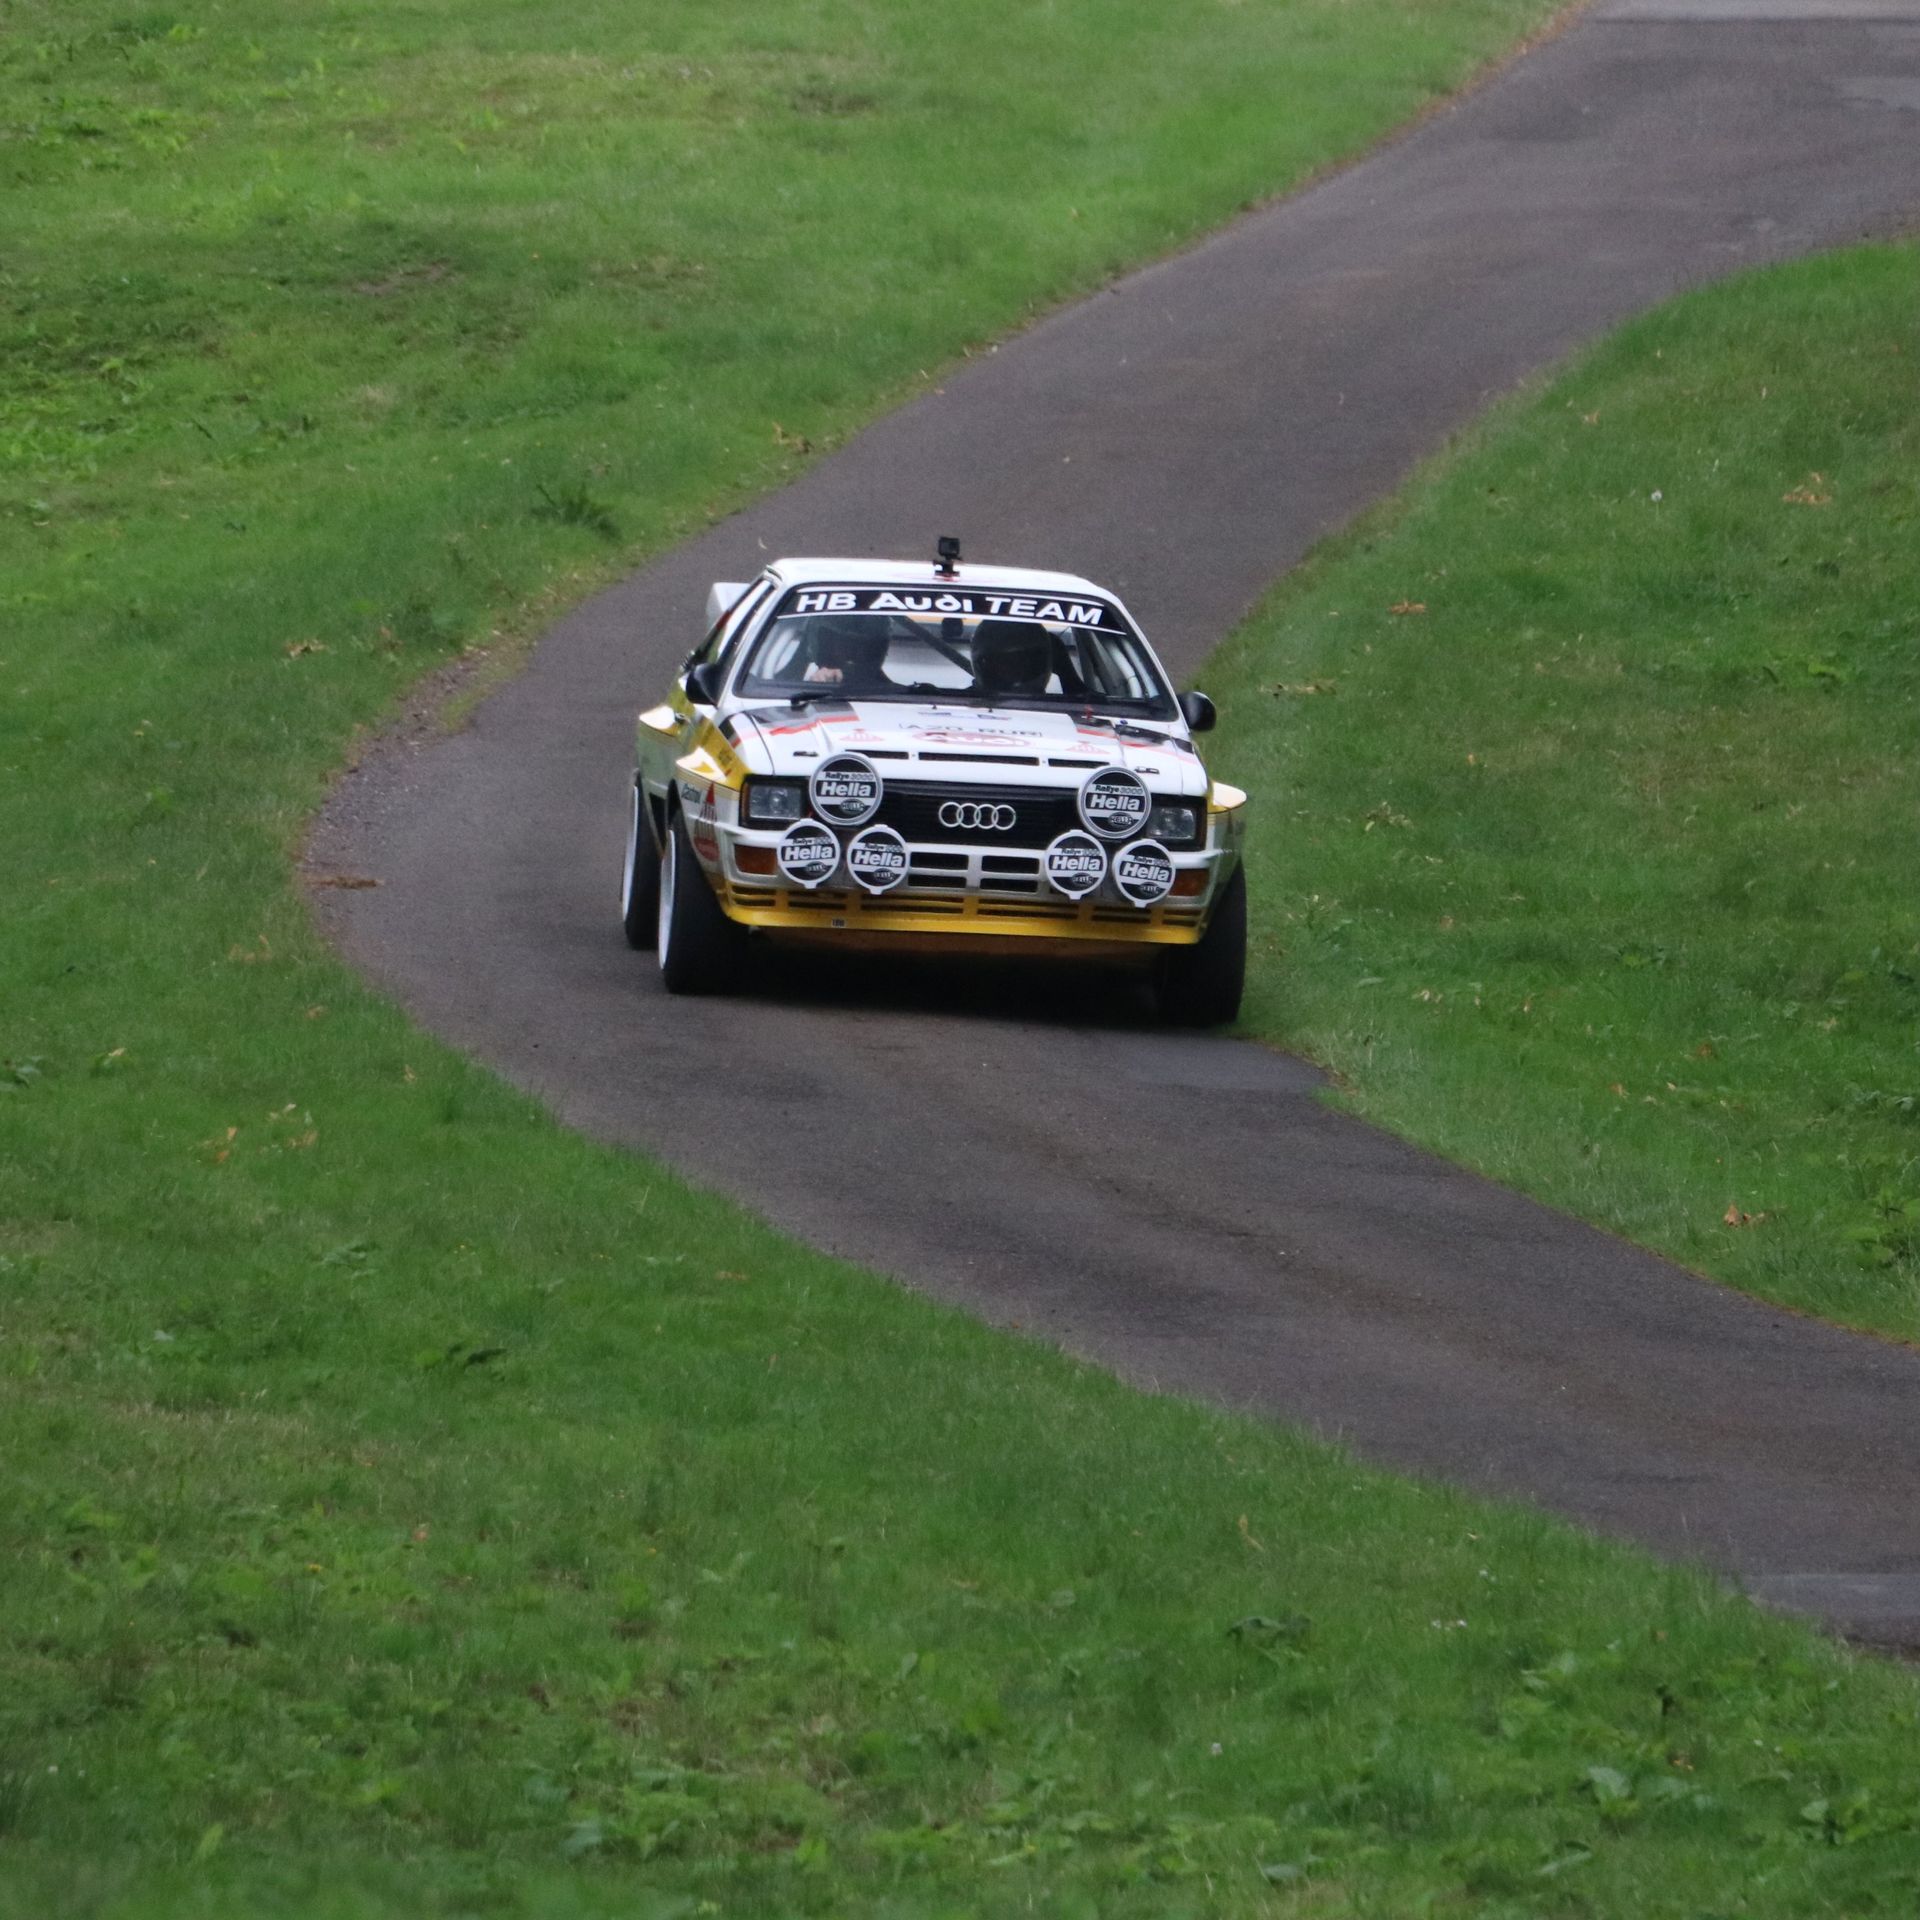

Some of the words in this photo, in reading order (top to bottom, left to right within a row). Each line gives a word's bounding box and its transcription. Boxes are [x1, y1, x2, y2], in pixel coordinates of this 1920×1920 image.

[796, 592, 857, 613] HB
[985, 596, 1103, 625] TEAM
[825, 772, 850, 781] Rallye
[820, 781, 872, 797] Hella
[1095, 784, 1120, 793] Rallye
[1090, 794, 1140, 811] Hella
[784, 845, 833, 860] Hella
[853, 850, 903, 867] Hella
[1052, 855, 1101, 871] Hella
[1121, 862, 1170, 881] Hella
